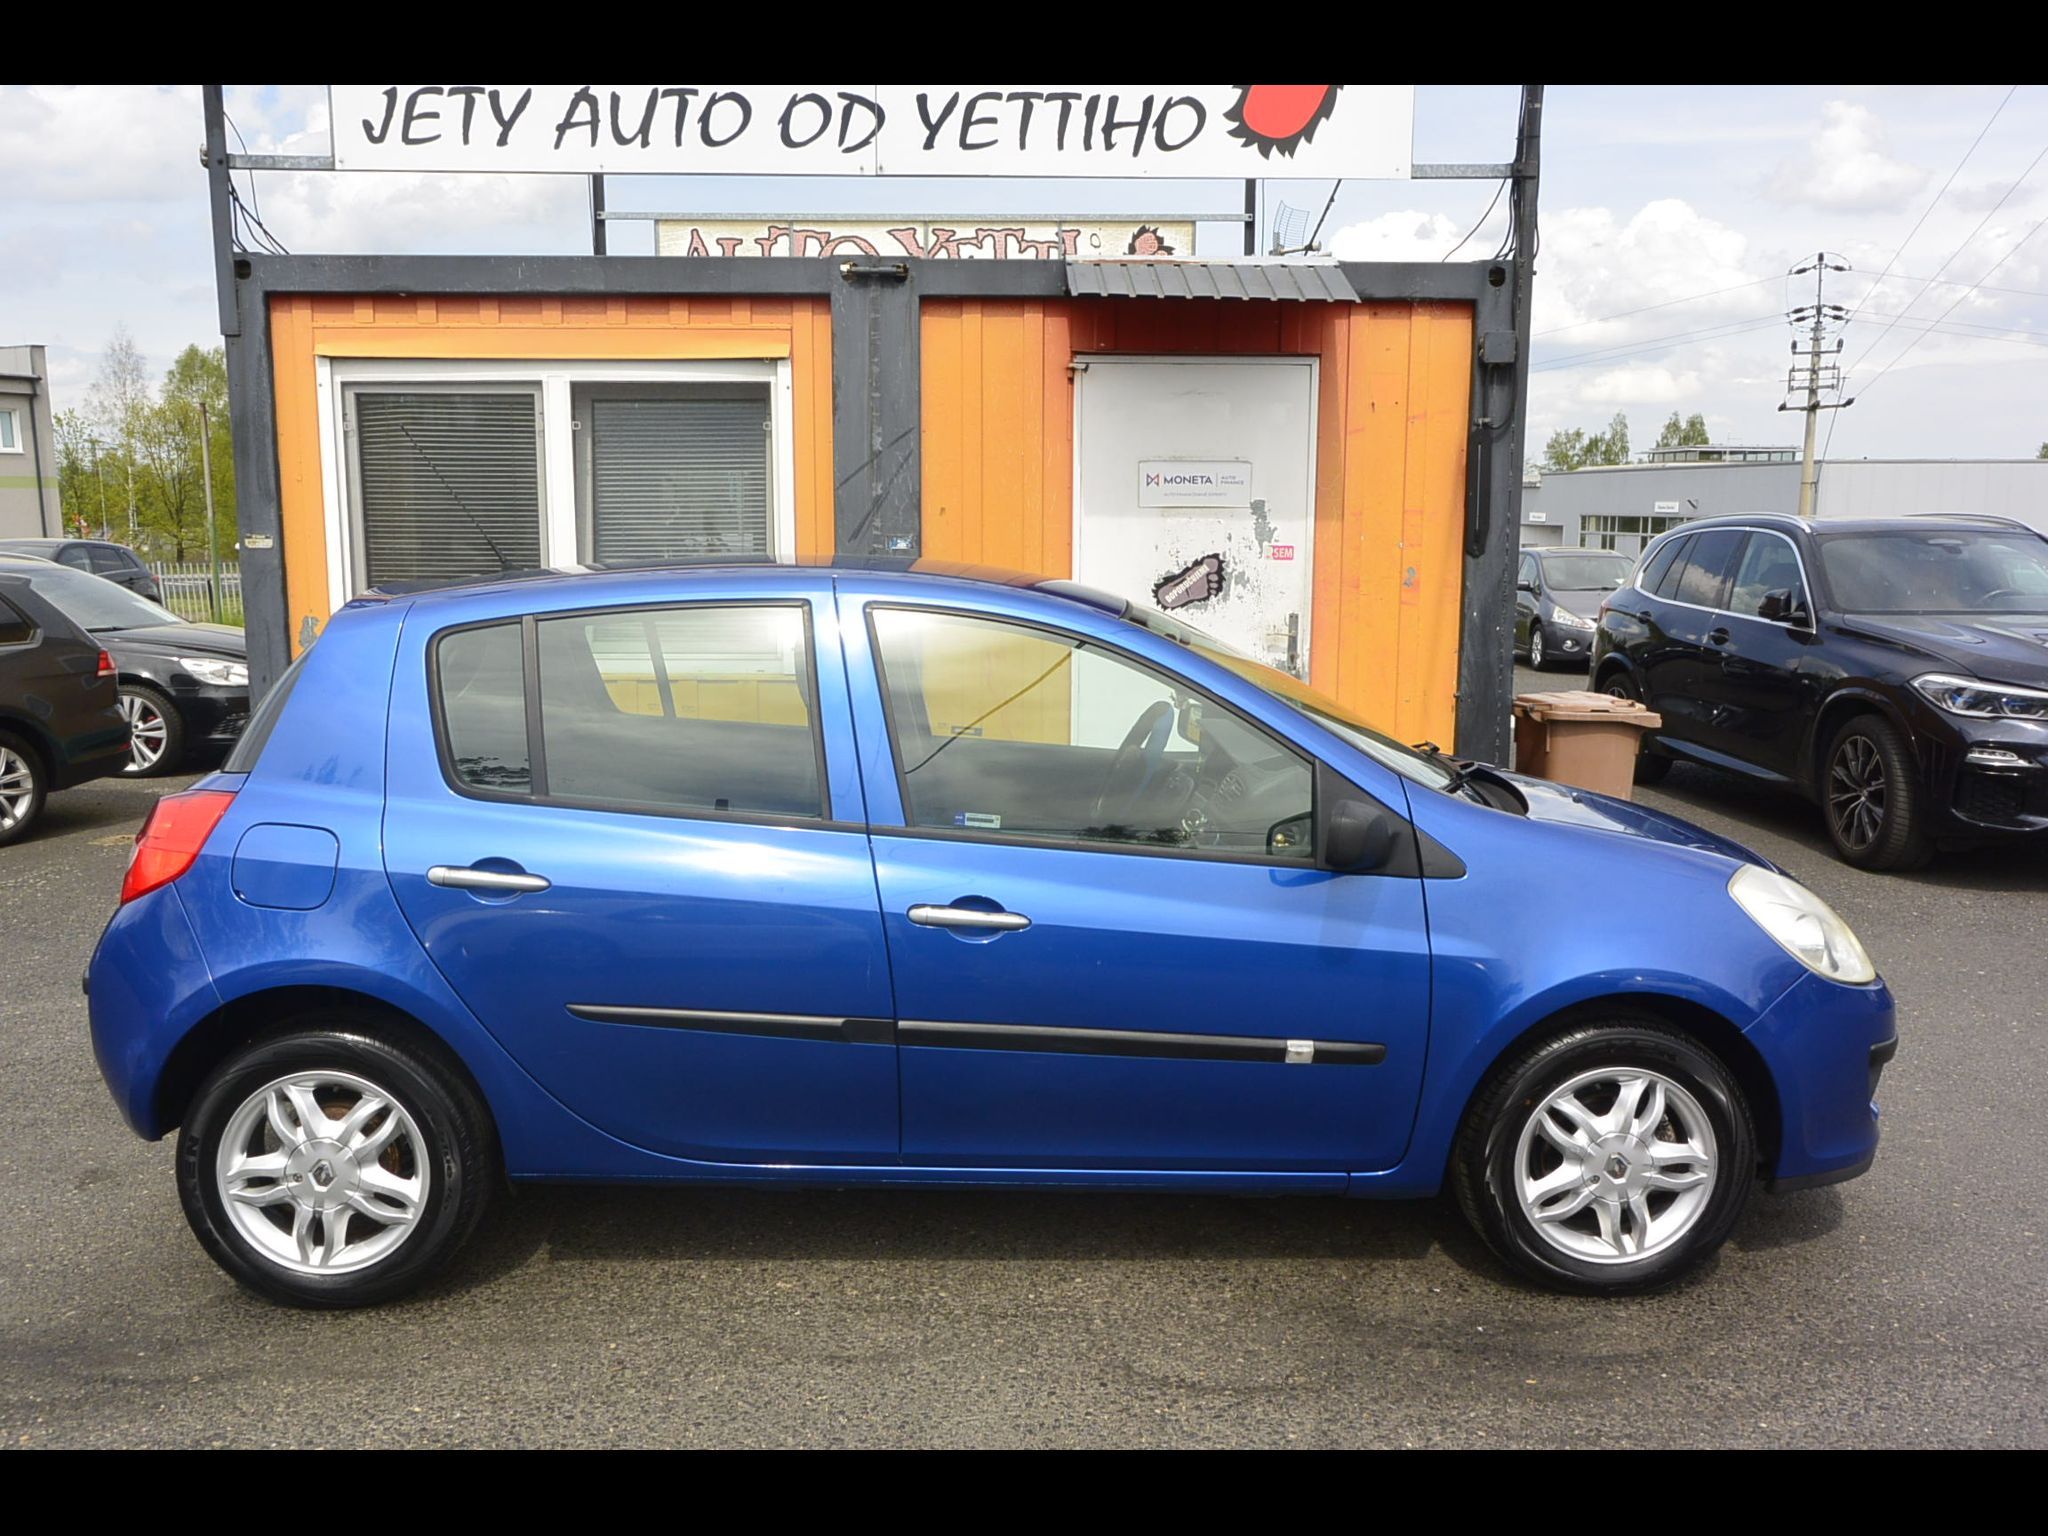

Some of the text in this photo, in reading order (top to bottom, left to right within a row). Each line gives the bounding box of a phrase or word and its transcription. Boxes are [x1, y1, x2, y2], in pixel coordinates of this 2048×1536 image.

[554, 86, 752, 150] AUTO
[777, 91, 886, 154] OD
[915, 91, 1207, 158] YETTIHO
[1163, 475, 1213, 485] MONETA
[1273, 546, 1293, 559] SEM
